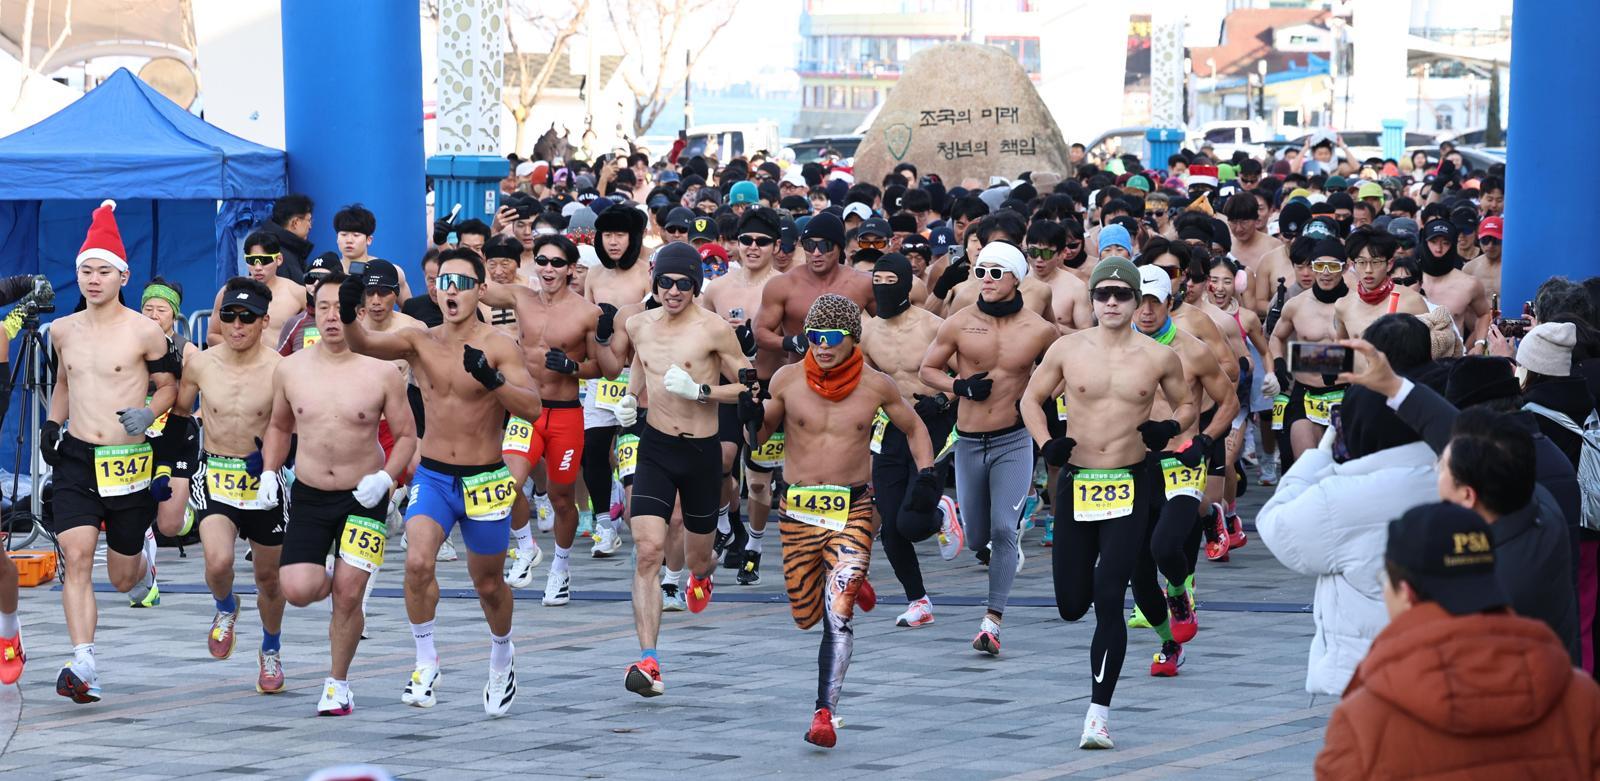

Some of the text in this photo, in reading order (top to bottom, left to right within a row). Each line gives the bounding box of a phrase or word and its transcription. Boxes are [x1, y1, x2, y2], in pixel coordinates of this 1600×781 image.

[919, 106, 1019, 127] 조국의 미래
[937, 137, 1036, 160] 청년의 책임
[1307, 399, 1329, 413] 14
[507, 424, 529, 439] 89
[100, 455, 150, 478] 1347
[1168, 467, 1206, 485] 137
[212, 472, 259, 491] 1542
[792, 493, 846, 512] 1439
[1079, 484, 1131, 502] 1283
[348, 527, 385, 558] 153
